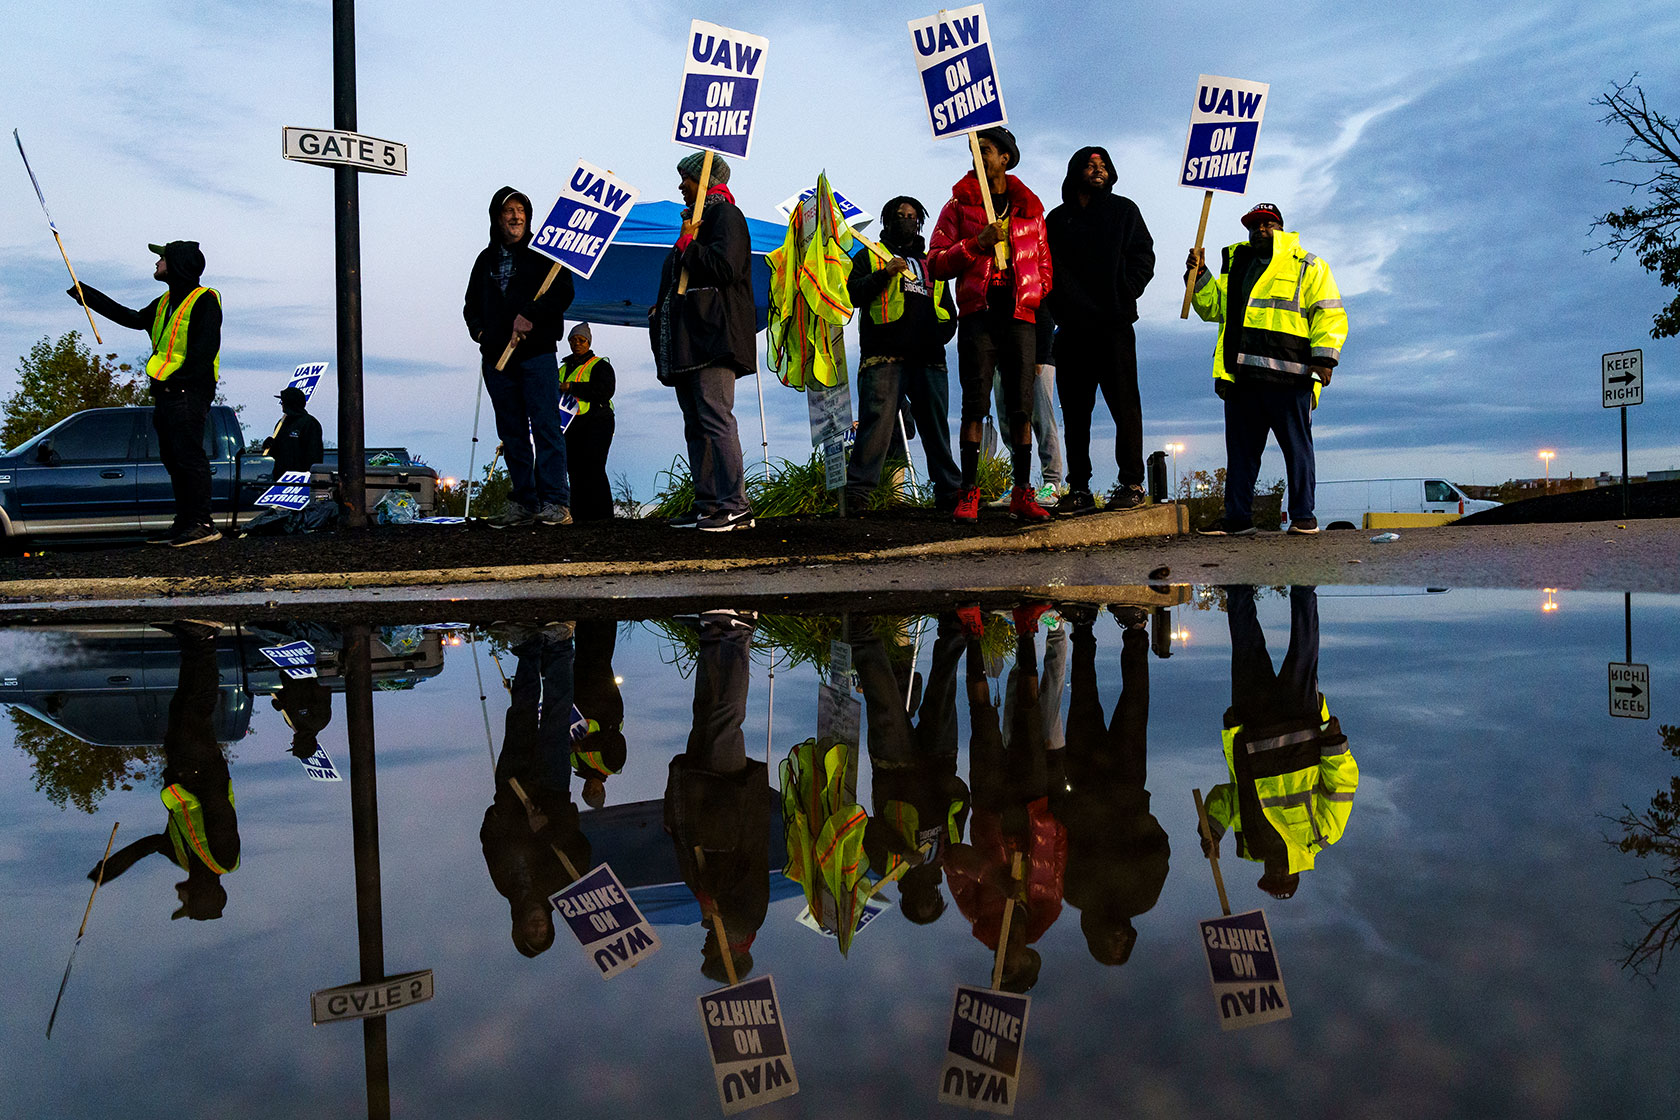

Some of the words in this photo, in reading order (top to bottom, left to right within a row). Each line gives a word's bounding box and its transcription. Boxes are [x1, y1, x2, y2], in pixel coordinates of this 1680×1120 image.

[914, 15, 979, 56] UAW
[692, 32, 762, 75] UAW
[945, 57, 971, 92] ON
[706, 81, 735, 108] ON
[933, 75, 996, 131] STRIKE
[1198, 86, 1262, 119] UAW
[680, 110, 750, 138] STRIKE
[299, 133, 374, 162] GATE
[383, 145, 396, 166] 5
[1210, 127, 1237, 152] ON
[1186, 151, 1250, 181] STRIKE
[570, 167, 632, 212] UAW
[568, 208, 599, 231] ON
[537, 225, 604, 257] STRIKE
[294, 366, 324, 377] UAW
[1607, 357, 1638, 371] KEEP
[1605, 386, 1640, 400] RIGHT
[282, 475, 307, 483] UA
[282, 486, 303, 494] ON
[261, 494, 309, 504] STRIKE
